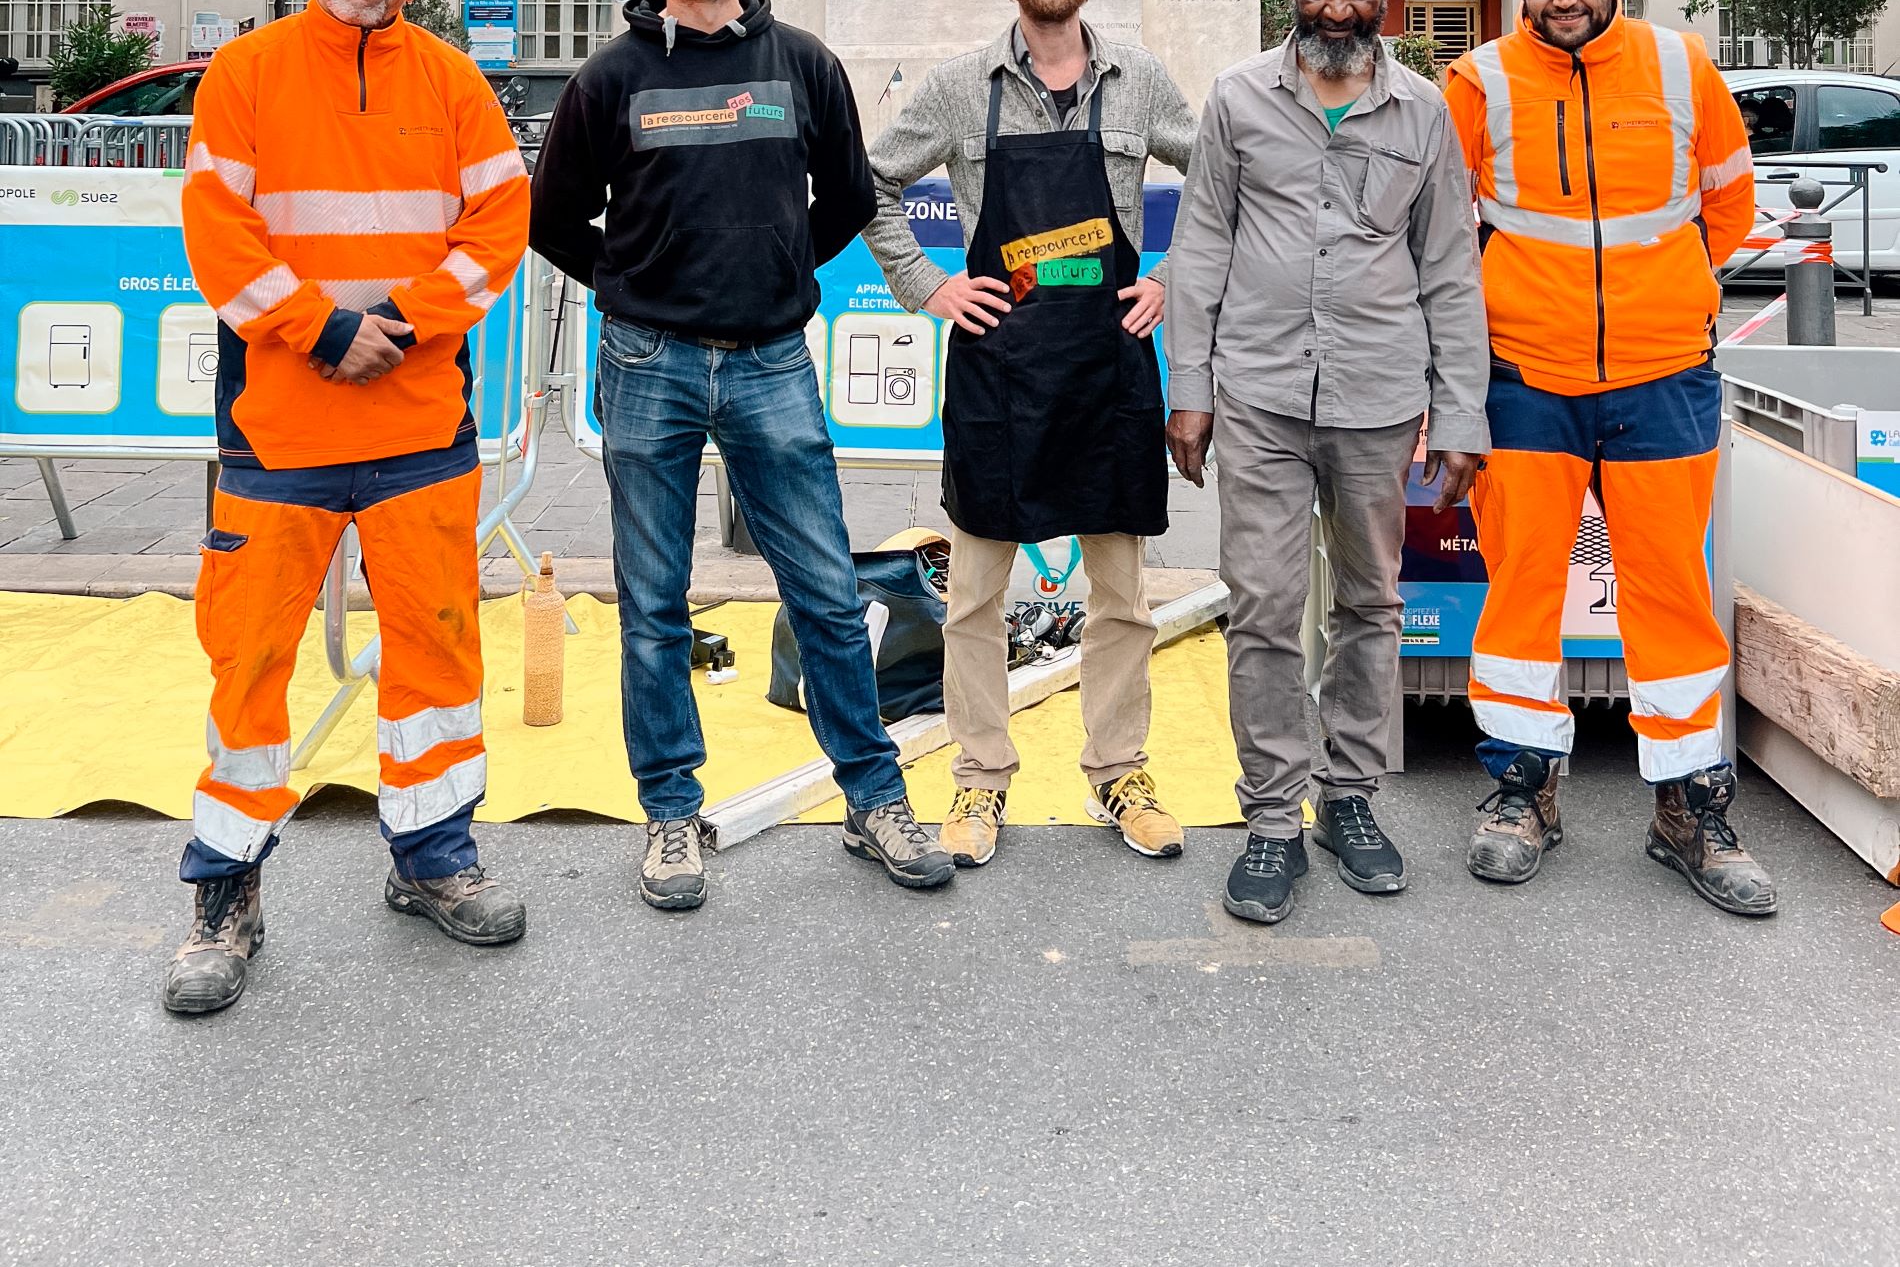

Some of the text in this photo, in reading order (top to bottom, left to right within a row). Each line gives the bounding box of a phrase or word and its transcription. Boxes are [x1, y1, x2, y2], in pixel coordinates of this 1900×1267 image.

[730, 96, 752, 109] des
[748, 105, 783, 118] futurs
[643, 116, 653, 126] la
[904, 201, 958, 221] ZONE
[1042, 262, 1099, 280] futurs
[119, 277, 160, 291] GROS
[1440, 535, 1478, 551] MÉTA
[1402, 607, 1430, 615] DOPTEZ
